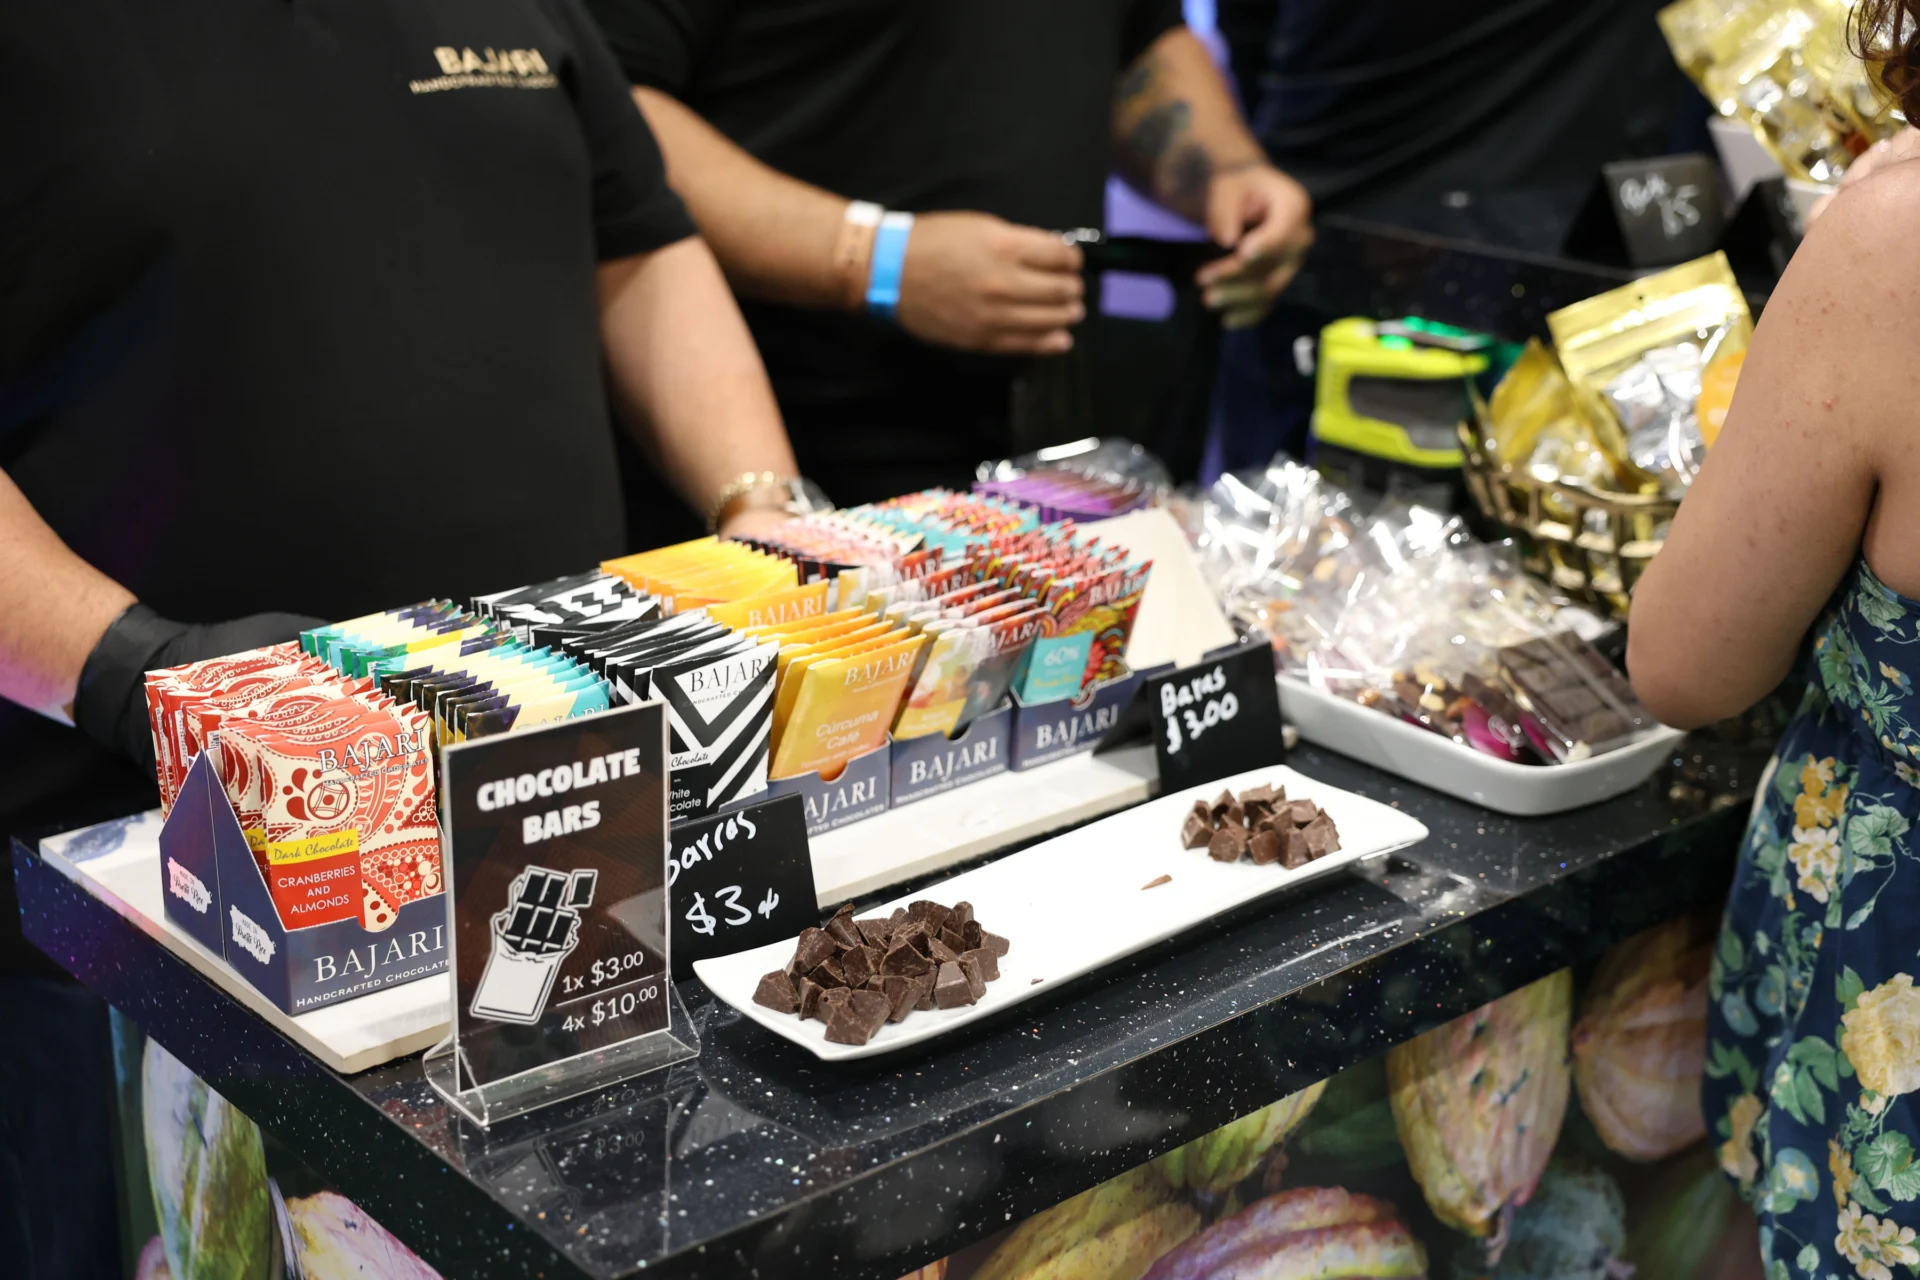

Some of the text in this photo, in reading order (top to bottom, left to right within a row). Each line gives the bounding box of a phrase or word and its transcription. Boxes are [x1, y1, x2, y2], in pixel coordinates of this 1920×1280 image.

[748, 594, 823, 628] BAJARI
[844, 647, 918, 686] BAJARI
[1036, 704, 1119, 749] BAJARI
[316, 728, 426, 774] BAJARI
[909, 736, 999, 785] BAJARI
[477, 747, 641, 812] CHOCOLATE
[804, 776, 878, 824] AJARI
[522, 800, 601, 845] BARS
[670, 797, 702, 812] colate
[274, 837, 355, 861] Dark Chocolate
[277, 865, 356, 888] CRANBERRIES
[307, 885, 331, 898] AND
[290, 894, 350, 915] ALMONDS
[313, 924, 445, 984] BAJARI
[562, 951, 644, 994] 1x $3.00
[296, 958, 450, 1008] HANDCRAFTED CHOCOLATE
[561, 985, 658, 1032] 4x $10.00
